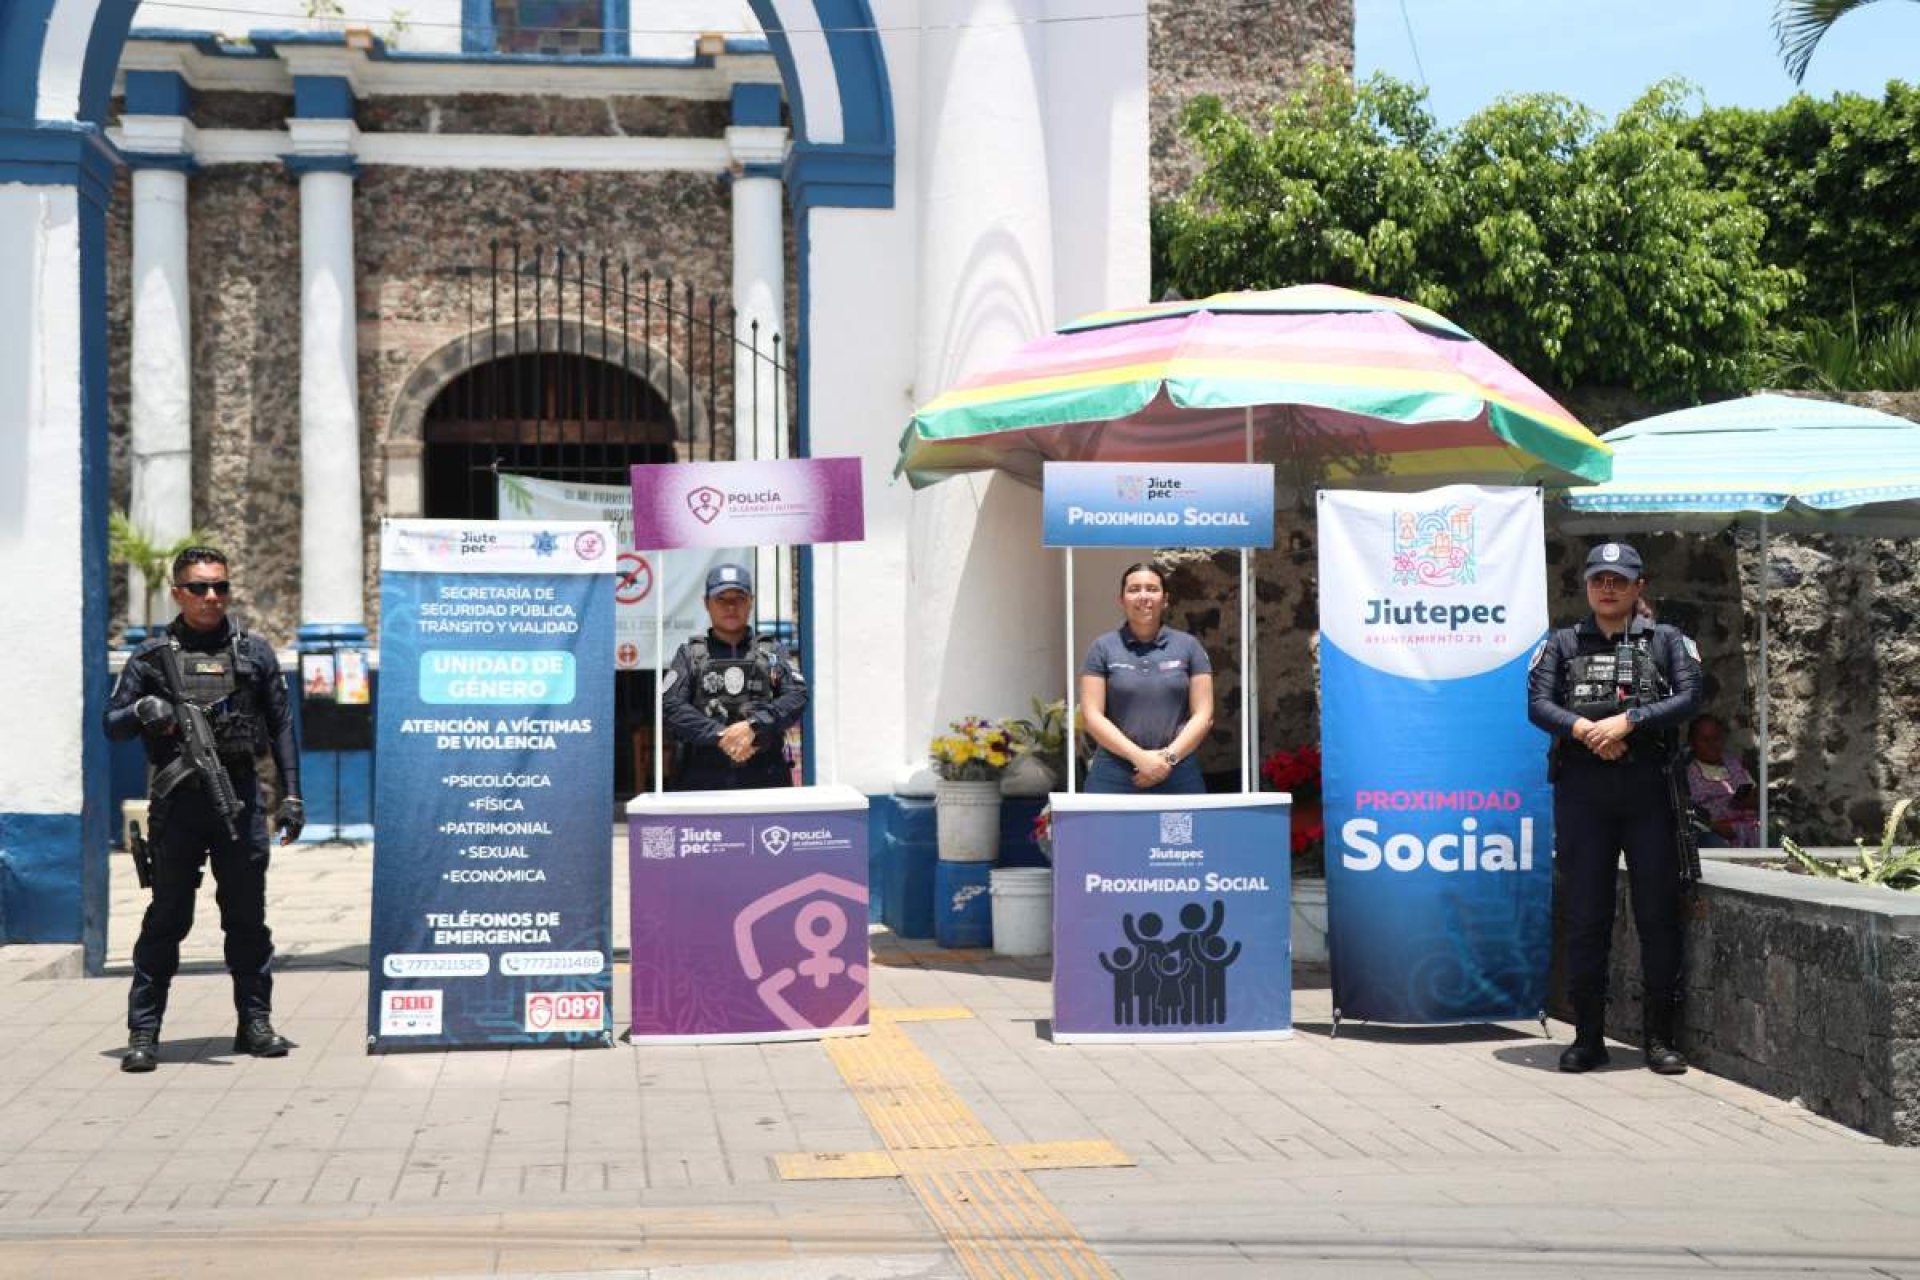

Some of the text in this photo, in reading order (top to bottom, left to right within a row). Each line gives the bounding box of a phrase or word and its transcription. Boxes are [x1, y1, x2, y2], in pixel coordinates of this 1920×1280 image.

[1148, 477, 1181, 489] Jiute
[728, 489, 781, 504] POLICÍA
[1148, 489, 1172, 500] pec
[1068, 507, 1249, 526] PROXIMIDAD SOCIAL
[460, 531, 497, 544] Jiute
[461, 543, 487, 555] pec
[440, 585, 555, 599] SECRETARÍA DE
[420, 604, 507, 616] SEGURIDAD
[1364, 598, 1506, 631] Jiutepec
[418, 619, 578, 633] TRÁNSITO Y VIALIDAD
[434, 656, 564, 675] UNIDAD DE
[449, 675, 547, 698] GÉNERO
[401, 717, 592, 733] ATENCIÓN A VÍCTIMAS
[437, 735, 557, 750] DE VIOLENCIA
[1356, 789, 1522, 811] PROXIMIDAD
[680, 827, 722, 842] Jiute
[792, 827, 832, 840] POLICÍA
[680, 843, 711, 858] pec
[1341, 817, 1534, 872] Social
[1149, 848, 1204, 861] Jiutepec
[1085, 873, 1269, 893] PROXIMIDAD SOCIAL
[426, 911, 560, 928] TELÉFONOS DE
[434, 928, 551, 945] EMERGENCIA
[392, 996, 599, 1017] 911 089
